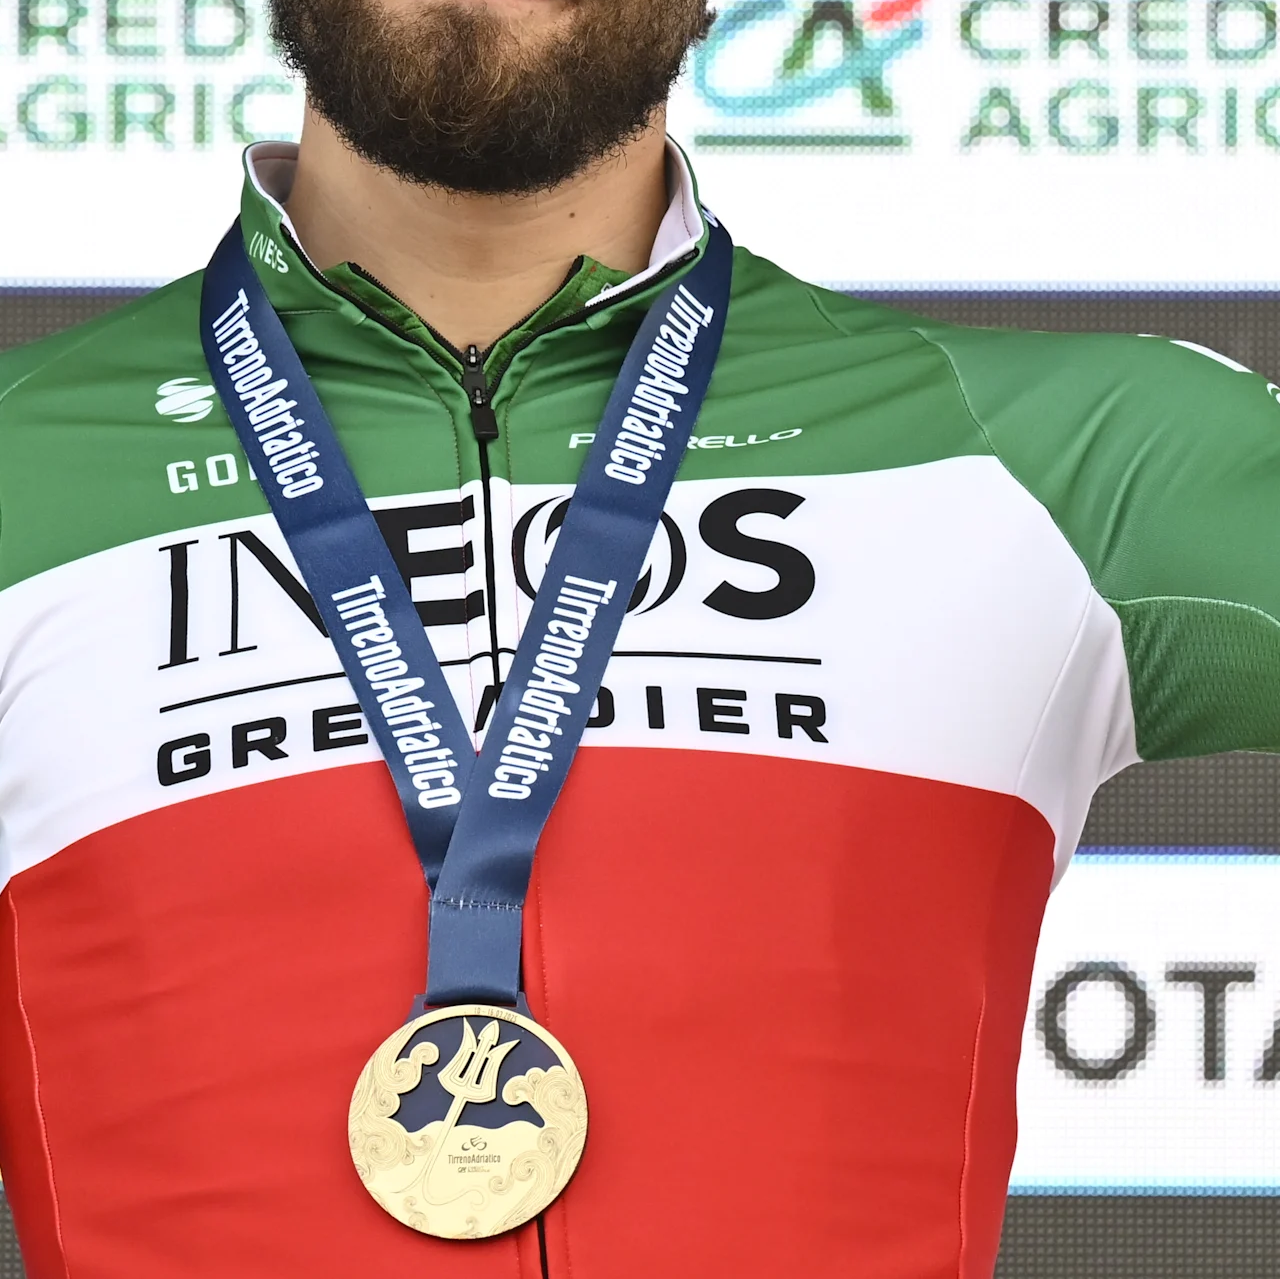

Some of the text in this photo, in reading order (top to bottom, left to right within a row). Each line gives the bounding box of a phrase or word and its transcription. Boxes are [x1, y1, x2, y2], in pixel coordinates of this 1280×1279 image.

[166, 453, 257, 494] GO
[212, 289, 324, 499] TirrenoAdriatico
[604, 284, 714, 486] TirrenoAdriatico
[331, 574, 462, 811] TirrenoAdriatico
[488, 574, 618, 800] TirrenoAdriatico
[447, 1153, 501, 1165] TirrenoAdriatico
